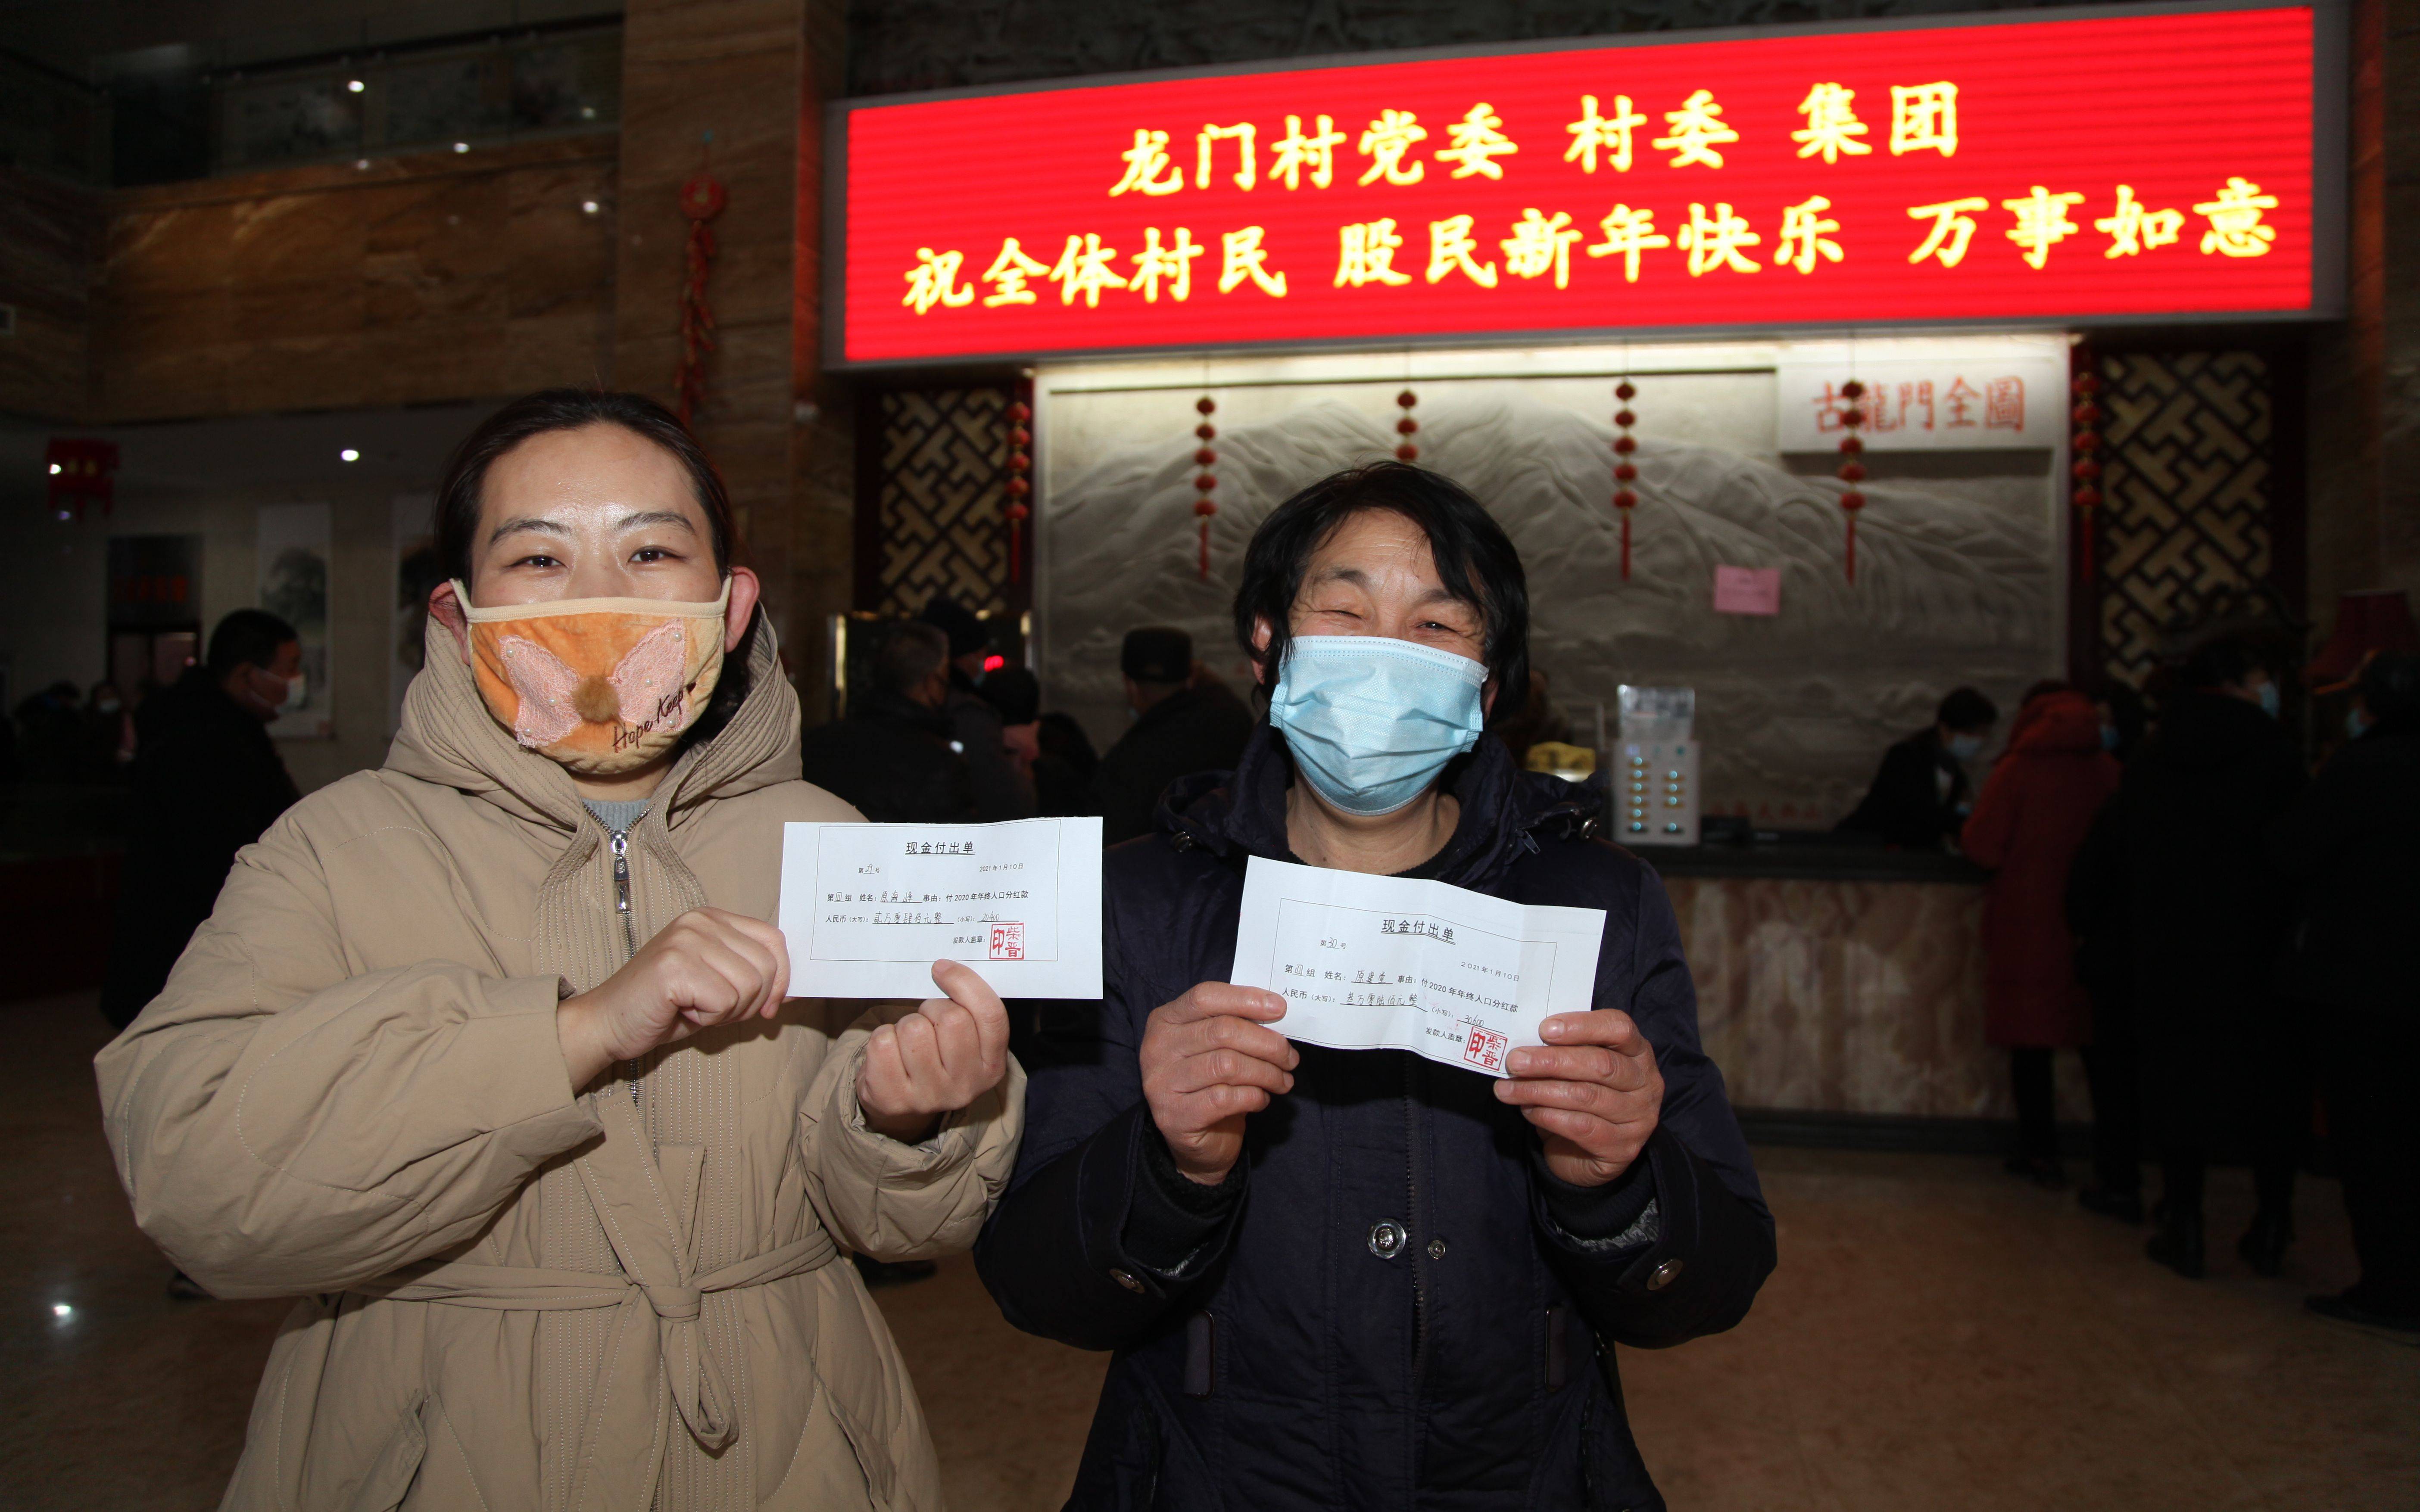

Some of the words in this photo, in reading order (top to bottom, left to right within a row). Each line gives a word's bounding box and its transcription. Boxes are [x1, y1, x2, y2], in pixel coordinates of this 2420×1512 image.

[1109, 103, 1518, 196] 龙门村党委
[1564, 90, 1739, 173] 村委
[1791, 81, 1958, 164] 集团
[902, 226, 1286, 314] 祝全体村民
[1334, 196, 1843, 289] 股民新年快乐
[1907, 177, 2278, 269] 万事如意
[613, 720, 653, 753] Hope
[906, 841, 974, 854] 现金付出单
[979, 863, 1023, 872] 2021年1月10日
[1382, 919, 1454, 941] 现金付出单
[1285, 964, 1315, 977] 第四组
[1461, 961, 1519, 982] 2021年1月10日
